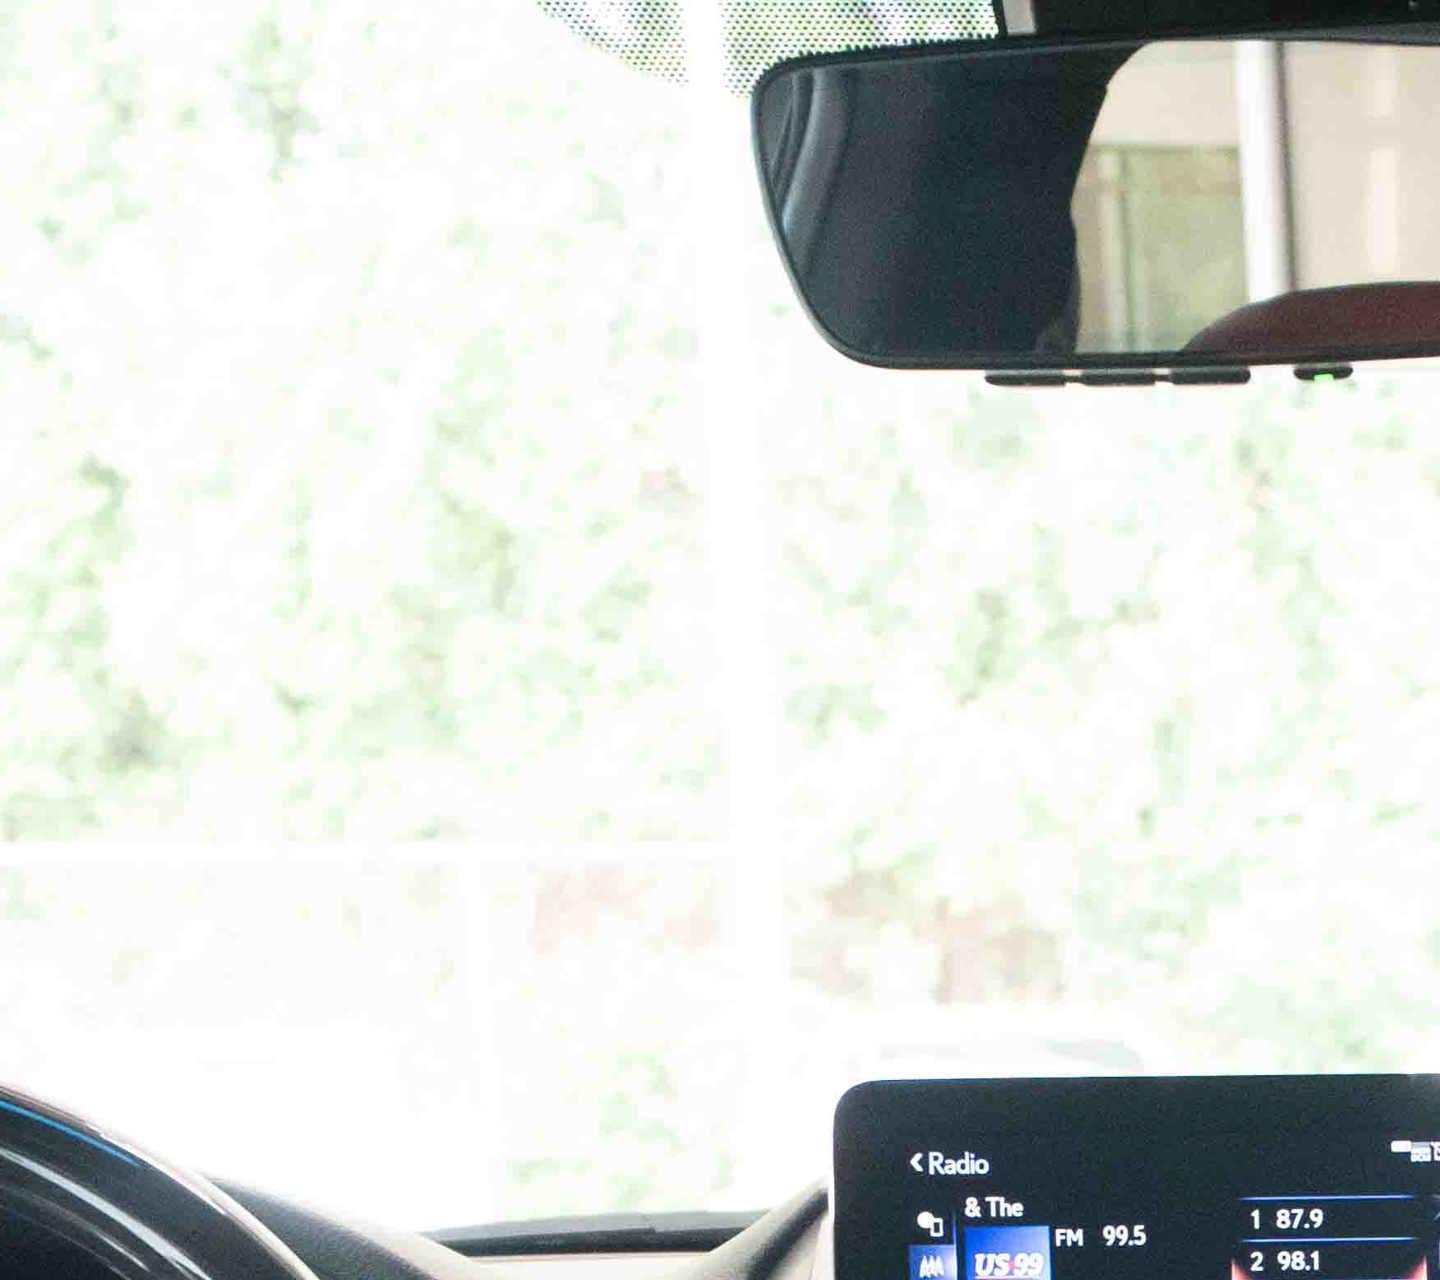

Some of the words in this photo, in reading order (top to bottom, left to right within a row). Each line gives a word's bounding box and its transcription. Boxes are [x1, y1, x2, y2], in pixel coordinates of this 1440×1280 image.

[928, 1151, 990, 1176] Radio
[964, 1196, 982, 1218] &
[984, 1195, 1024, 1218] The
[1250, 1208, 1260, 1230] 1
[1275, 1208, 1324, 1230] 87.9
[1054, 1228, 1084, 1247] FM
[1102, 1224, 1147, 1247] 99.5
[1250, 1251, 1265, 1272] 2
[1276, 1250, 1320, 1272] 98.1
